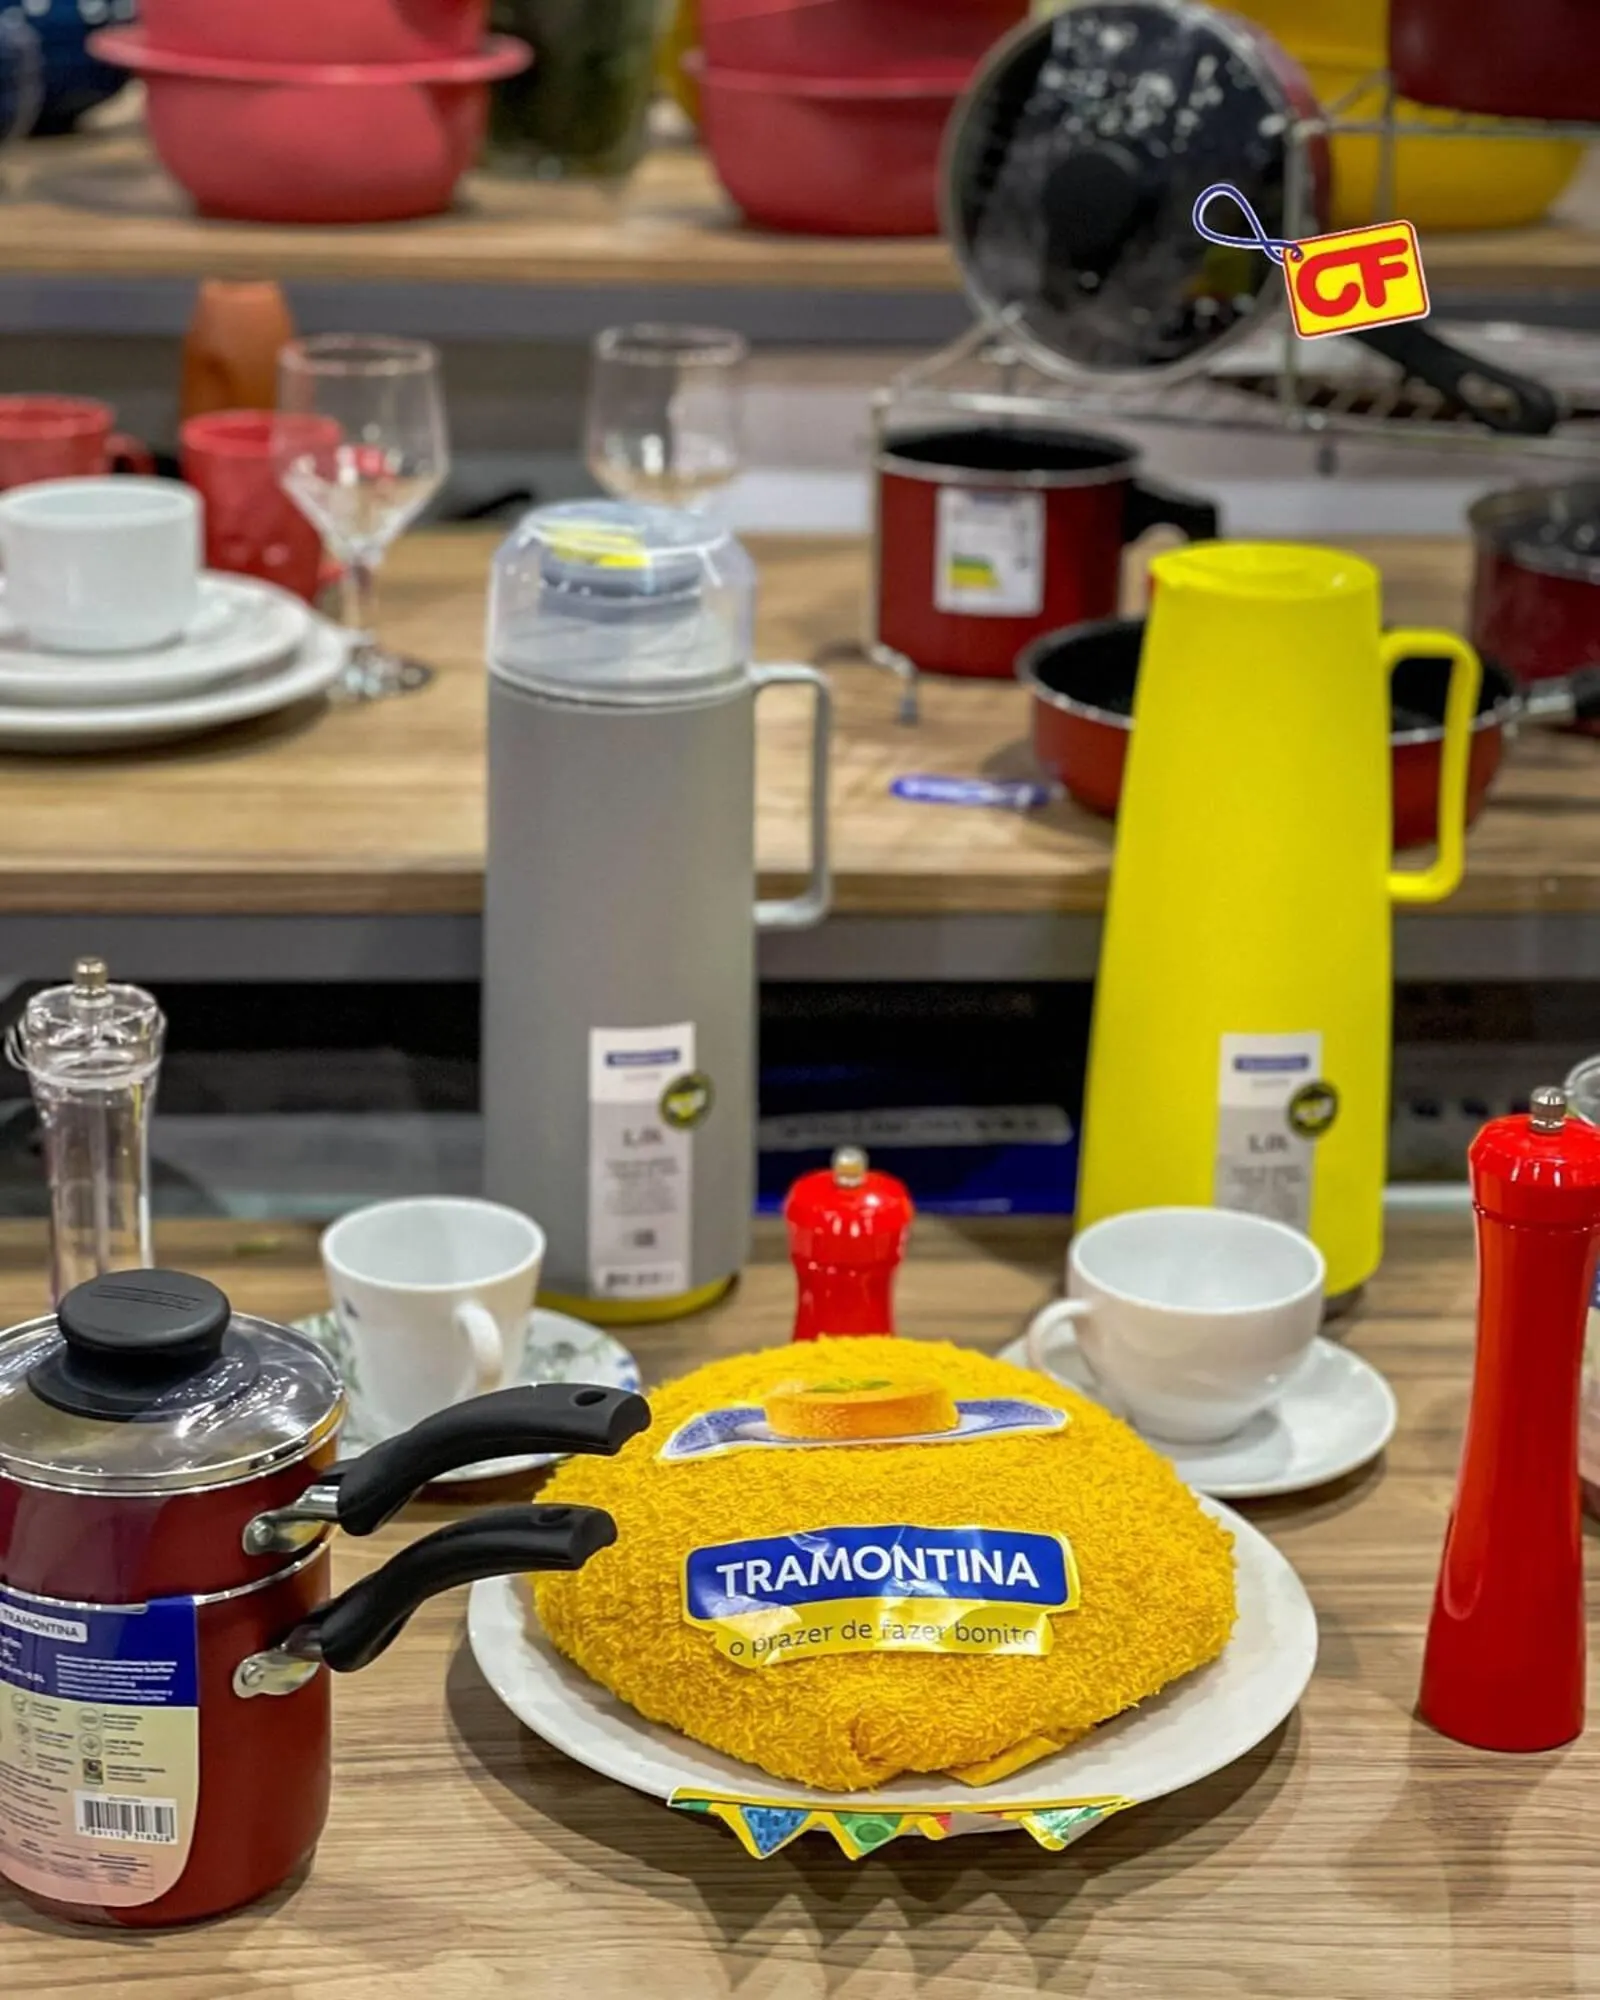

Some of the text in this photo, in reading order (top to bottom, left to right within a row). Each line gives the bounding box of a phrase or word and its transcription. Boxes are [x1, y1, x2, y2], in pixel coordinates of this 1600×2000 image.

[716, 1545, 1040, 1599] TRAMONTINA
[2, 1608, 79, 1637] TRAMONTINA
[729, 1620, 1039, 1656] o prazer de fazer bonito
